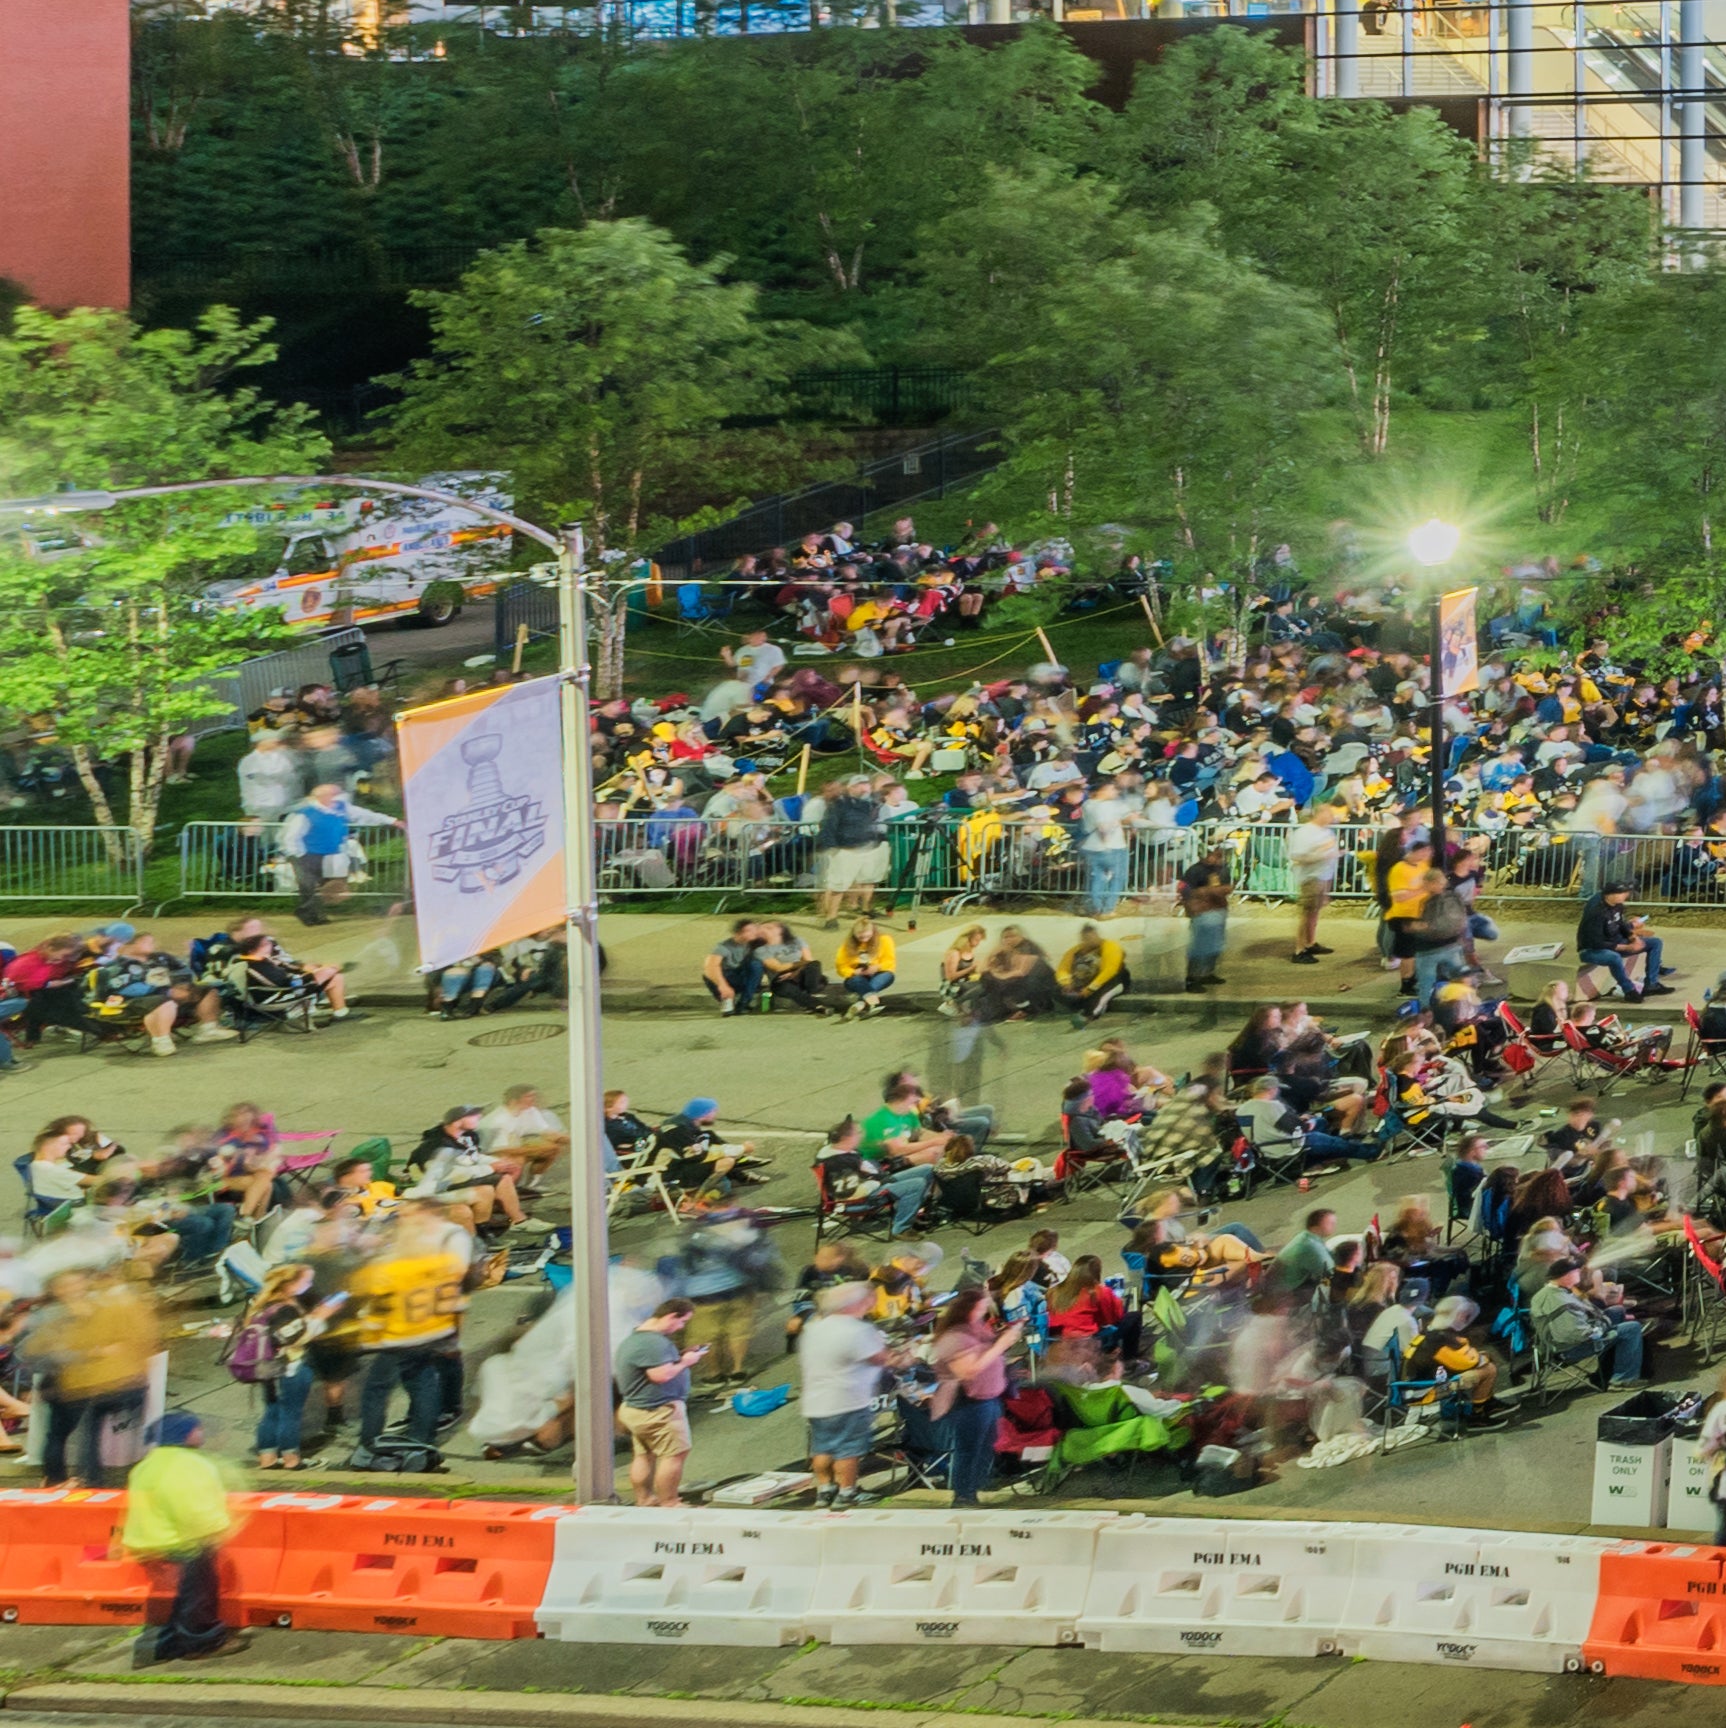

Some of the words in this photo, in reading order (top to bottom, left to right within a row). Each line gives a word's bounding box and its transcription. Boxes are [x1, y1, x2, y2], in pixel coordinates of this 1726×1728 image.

[427, 801, 549, 860] FINAL
[1609, 1453, 1643, 1465] TRASH
[1686, 1456, 1707, 1465] TRA
[1612, 1466, 1638, 1477] ONLY
[1688, 1467, 1705, 1476] ON
[383, 1533, 418, 1547] PGH
[422, 1535, 455, 1549] EMA
[653, 1541, 688, 1555] PGH
[691, 1542, 725, 1556] EMA
[920, 1543, 954, 1557] PGH
[959, 1544, 993, 1558] EMA
[1192, 1552, 1225, 1565] PGH
[1229, 1553, 1262, 1566] EMA
[1444, 1562, 1475, 1576] PGH
[1480, 1564, 1510, 1578] EMA
[1687, 1581, 1717, 1595] PGH
